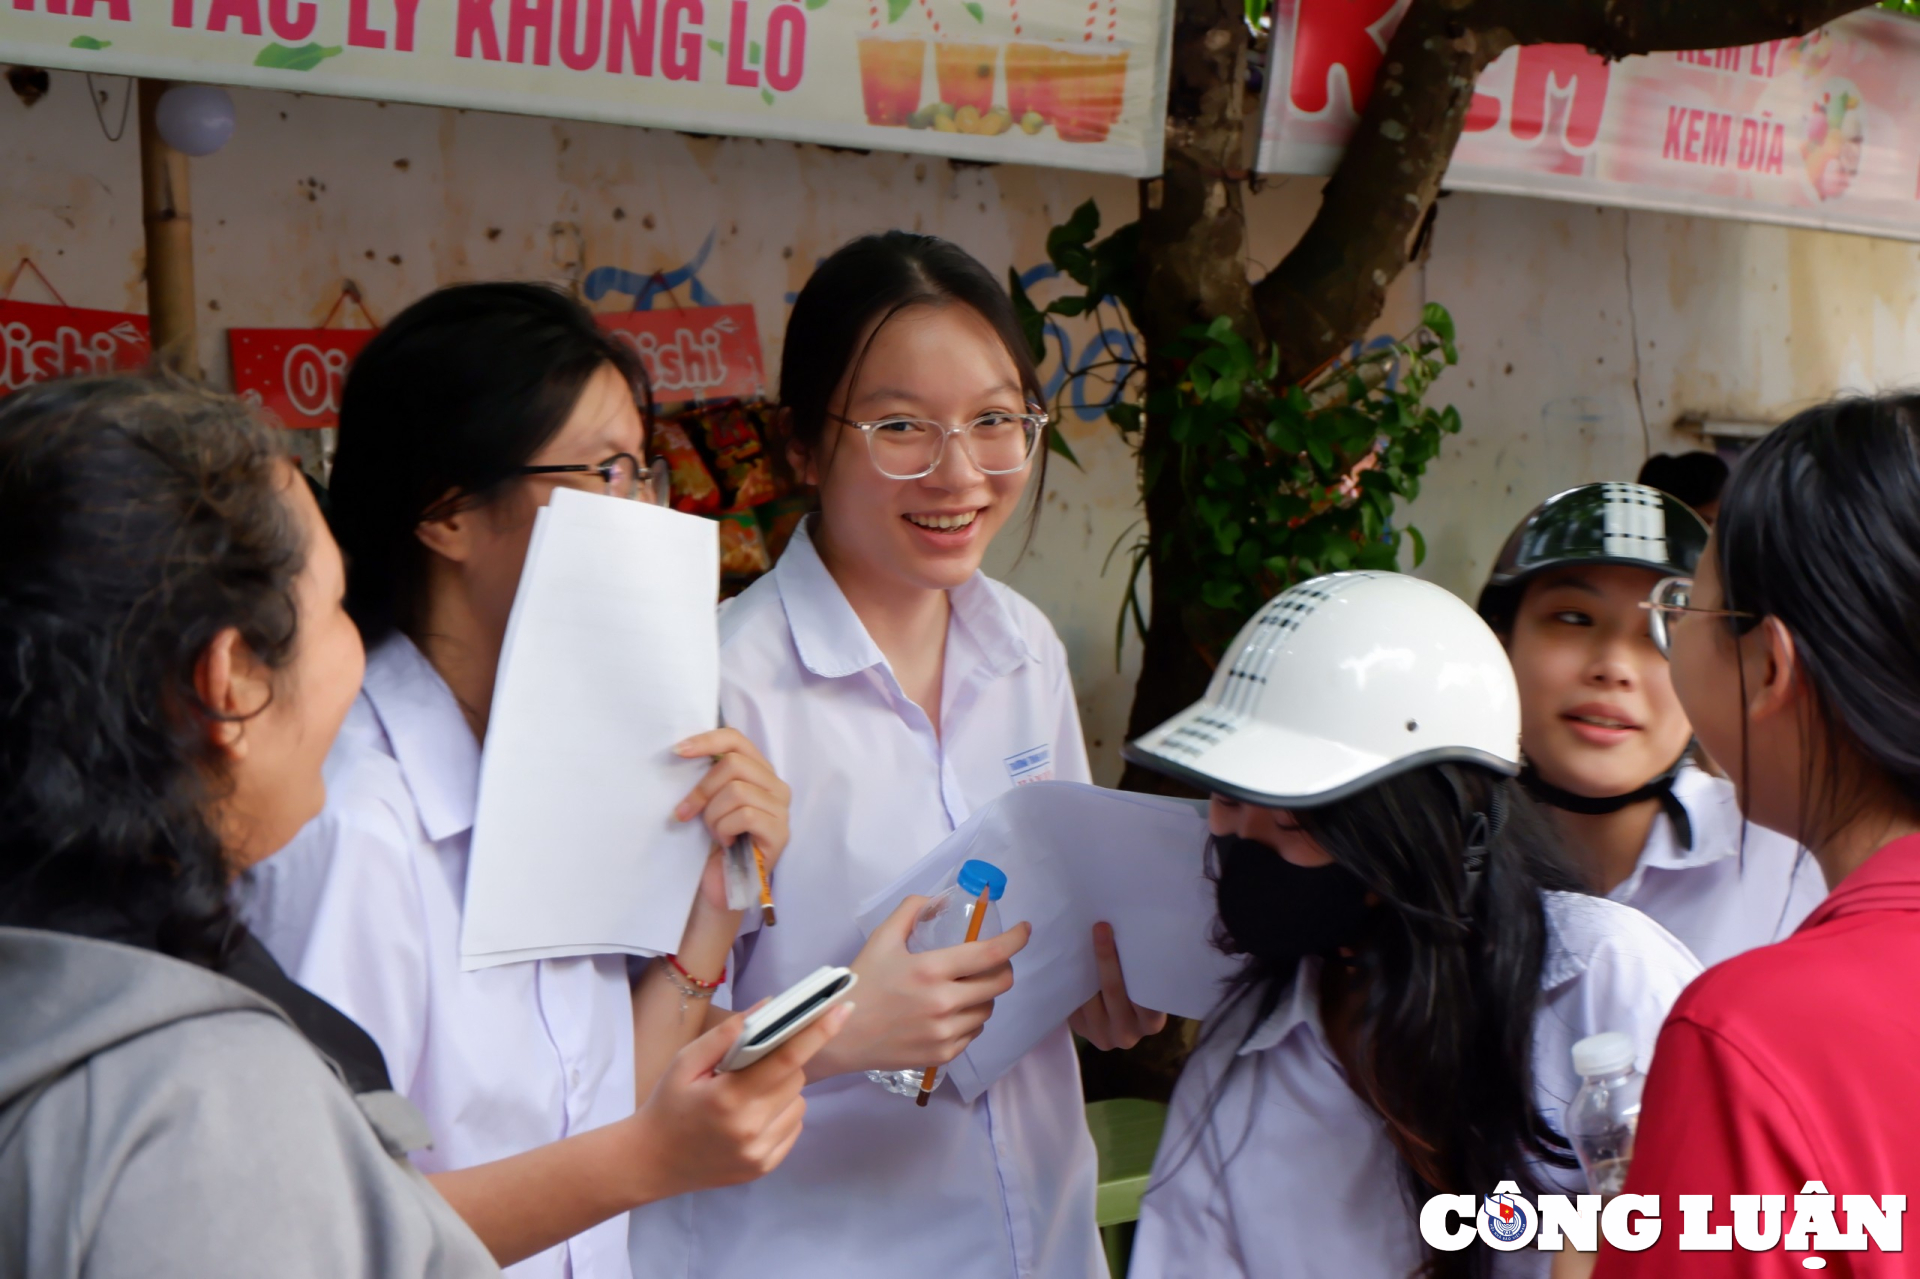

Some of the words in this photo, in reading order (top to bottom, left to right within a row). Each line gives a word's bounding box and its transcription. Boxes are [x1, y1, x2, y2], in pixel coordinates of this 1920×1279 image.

[1662, 105, 1733, 167] KEM
[1737, 110, 1786, 175] ĐĨA
[0, 320, 118, 390] ishi
[612, 326, 729, 391] ishi
